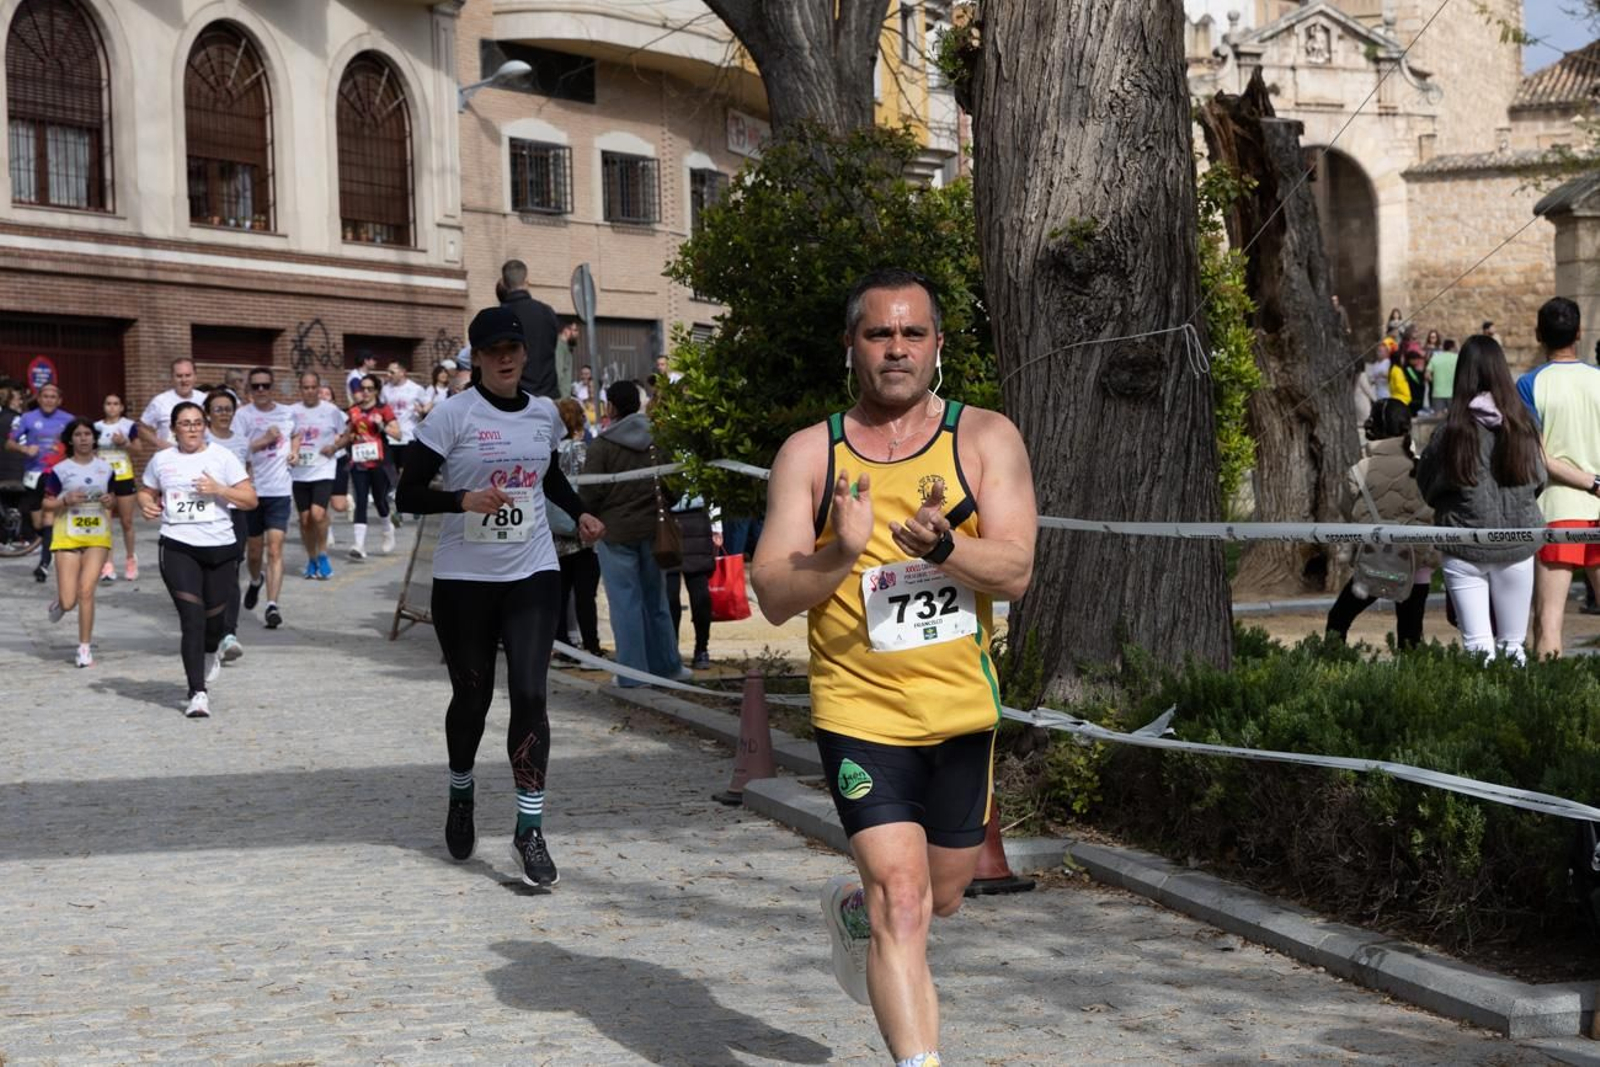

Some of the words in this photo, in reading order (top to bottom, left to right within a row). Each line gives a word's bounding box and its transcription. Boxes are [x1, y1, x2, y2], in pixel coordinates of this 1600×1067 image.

[177, 501, 205, 512] 276
[75, 517, 99, 526] 264
[482, 508, 523, 526] 780
[1488, 531, 1534, 542] DEPORTES
[888, 586, 959, 624] 732
[914, 618, 943, 628] FRANCISCO
